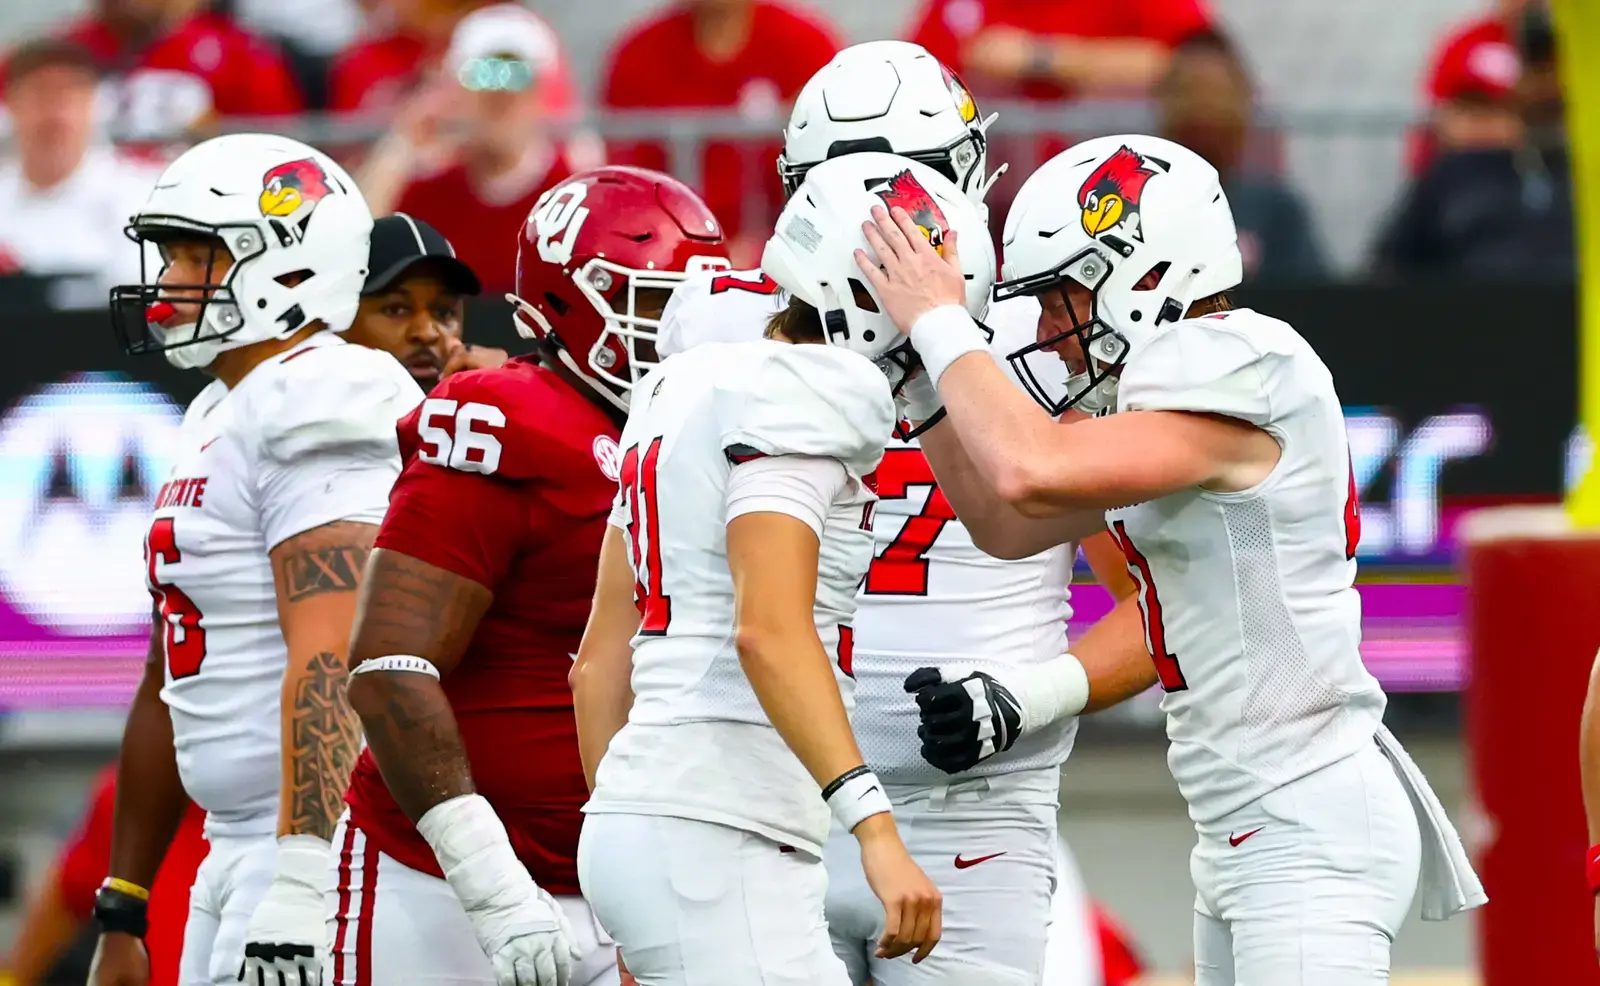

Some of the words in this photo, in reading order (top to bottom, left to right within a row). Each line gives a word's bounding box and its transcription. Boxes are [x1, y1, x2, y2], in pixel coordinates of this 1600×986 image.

[535, 182, 590, 265] OU
[417, 398, 507, 476] 56
[144, 515, 207, 681] 6
[380, 659, 428, 671] JORDAN
